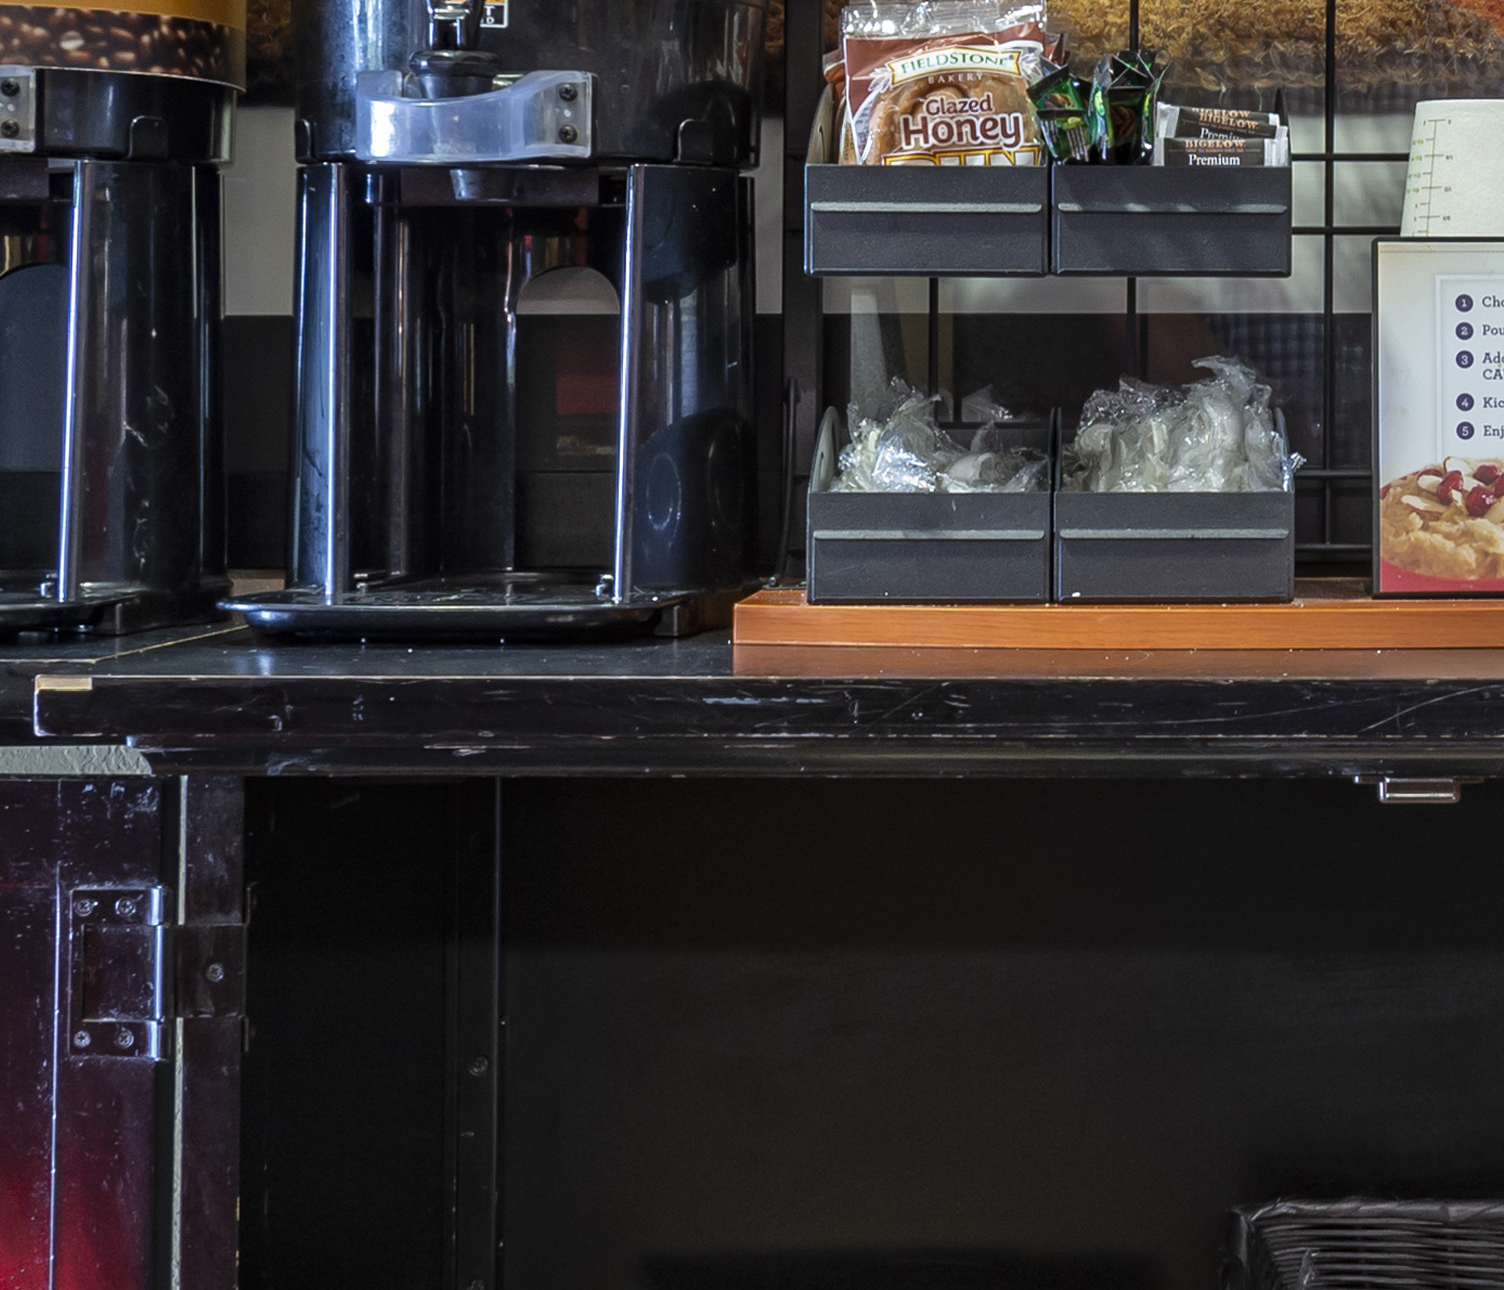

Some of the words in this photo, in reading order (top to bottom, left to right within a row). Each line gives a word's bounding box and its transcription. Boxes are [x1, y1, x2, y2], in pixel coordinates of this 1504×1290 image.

[901, 53, 1007, 74] FIELDSTONE
[928, 73, 984, 85] BAKERY
[925, 93, 993, 116] Glazed
[902, 114, 1023, 149] Honey
[1188, 154, 1240, 166] Premium
